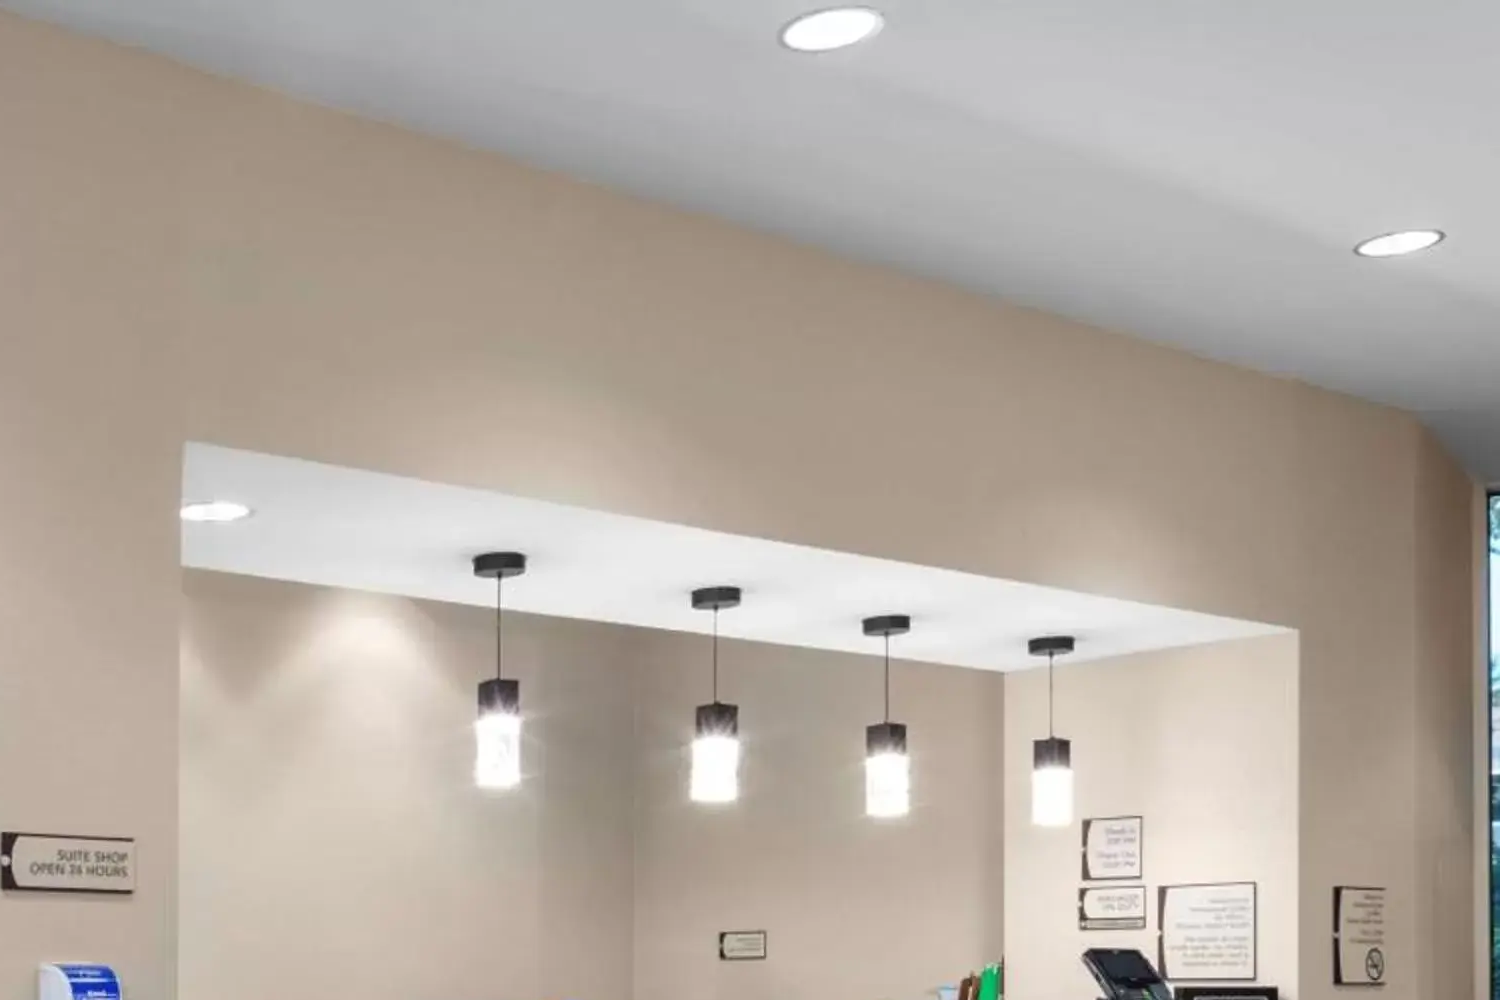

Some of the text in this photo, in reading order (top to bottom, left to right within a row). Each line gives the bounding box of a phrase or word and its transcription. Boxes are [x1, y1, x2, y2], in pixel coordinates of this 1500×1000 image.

[57, 849, 128, 863] SUITE SHOP
[29, 862, 128, 877] OPEN 24 HOURS
